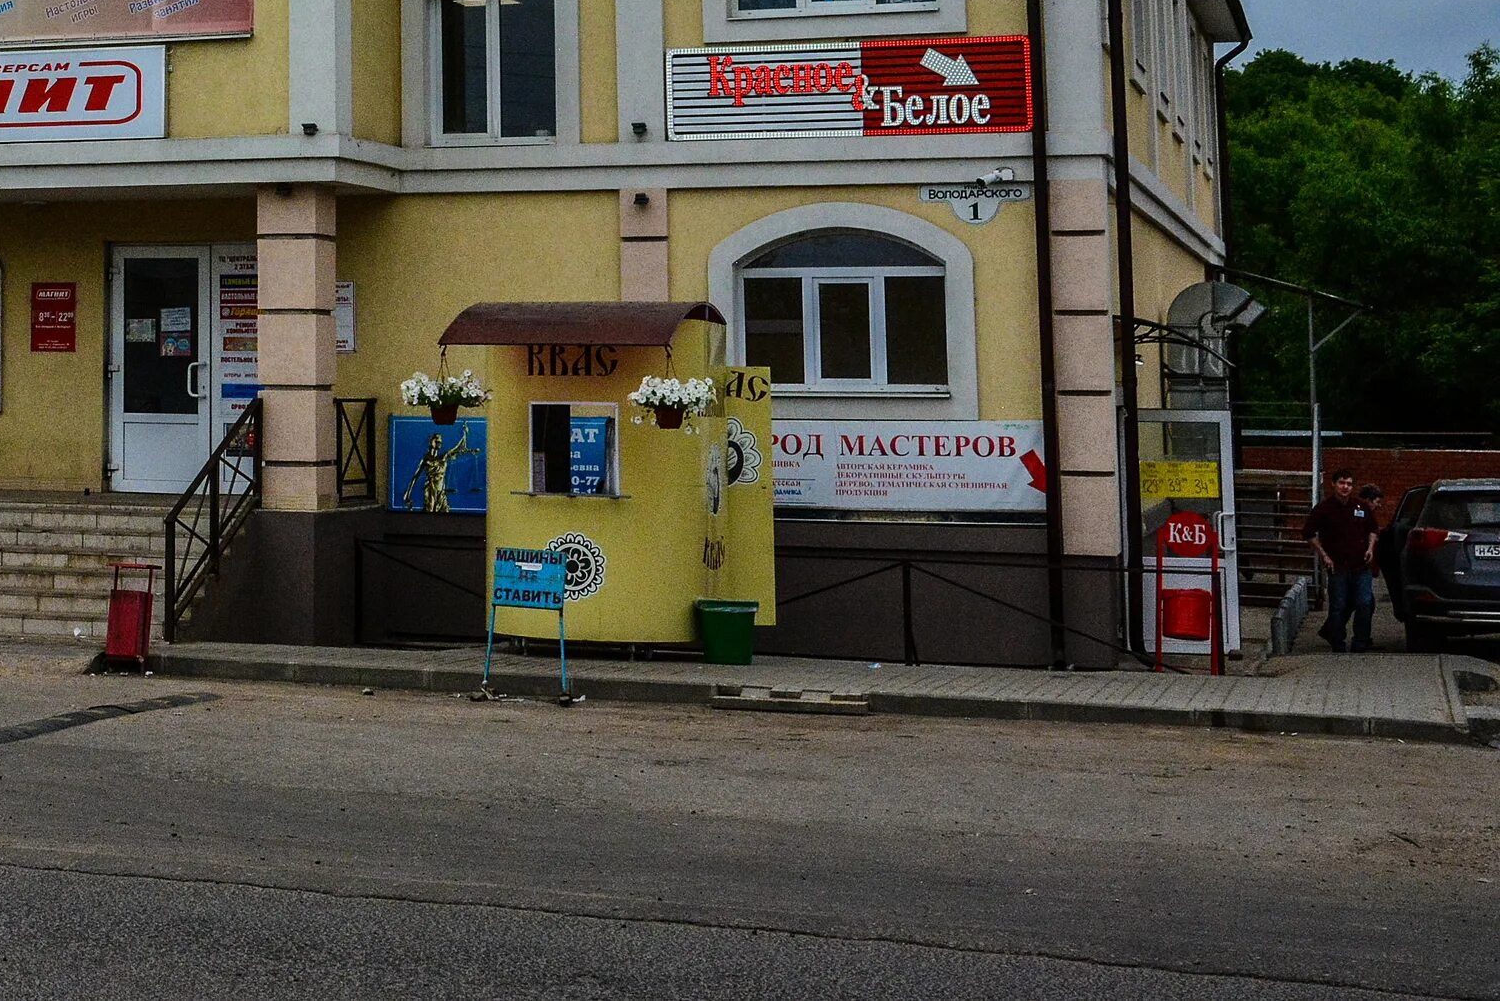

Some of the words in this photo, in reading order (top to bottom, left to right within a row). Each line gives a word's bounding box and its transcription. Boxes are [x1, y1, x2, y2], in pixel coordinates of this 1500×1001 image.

[70, 7, 99, 24] игры
[707, 55, 854, 107] Красное
[880, 84, 991, 127] Белое
[928, 188, 1023, 200] ВОЛОДАРСКОГО
[968, 202, 982, 221] 1
[840, 434, 1016, 458] МАСТЕРОВ
[835, 463, 885, 471] АВТОРСКАЯ
[887, 463, 934, 471] КЕРАМИКА
[496, 549, 563, 565] МАШИНЫ
[493, 587, 563, 604] СТАВИТЬ
